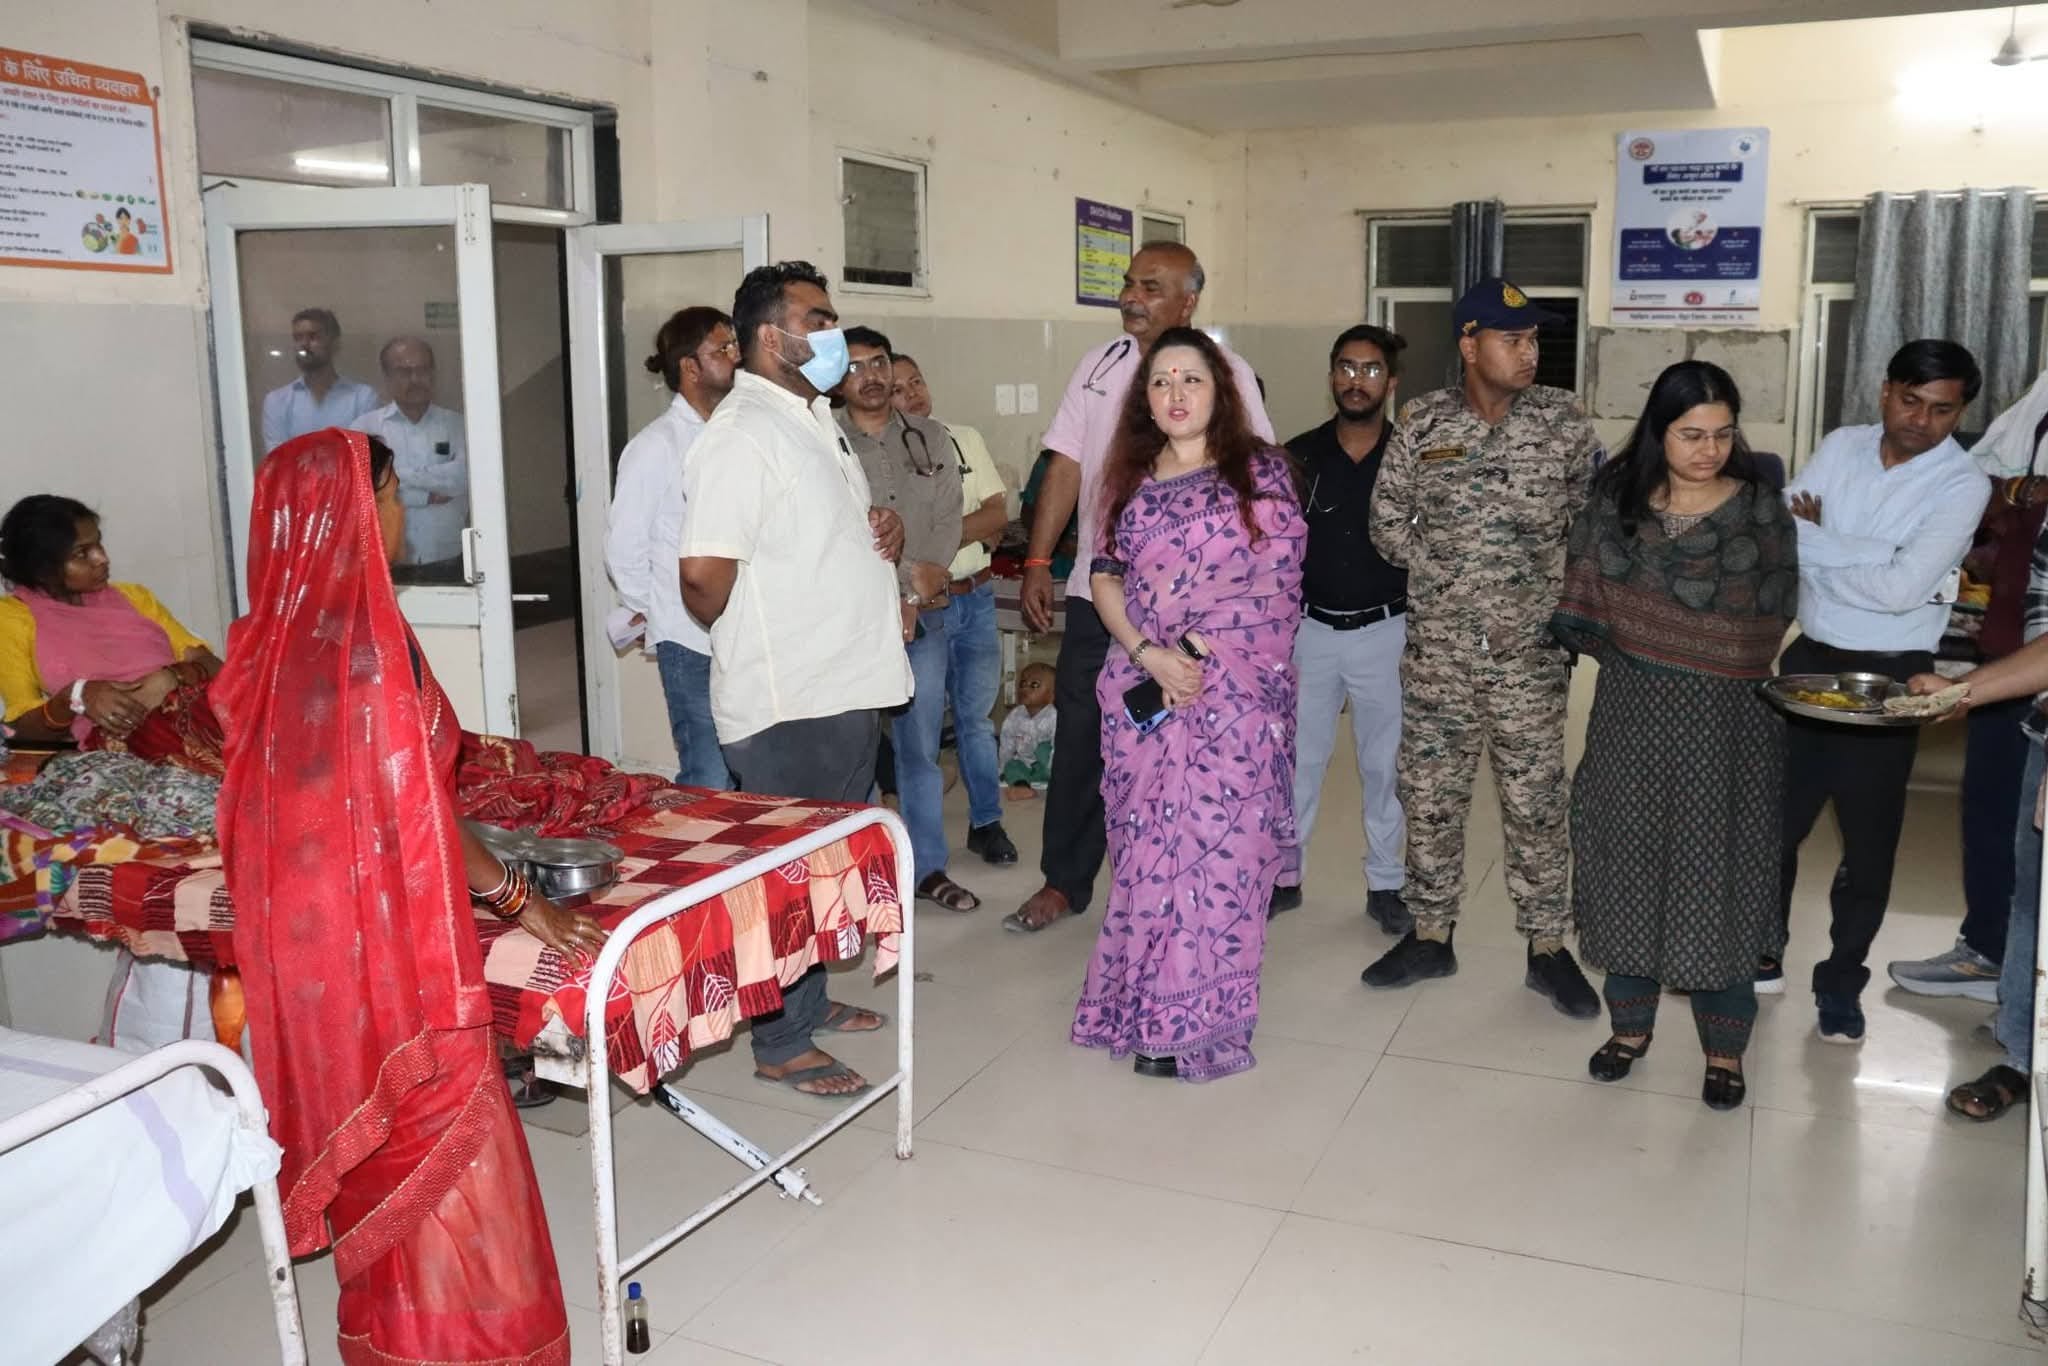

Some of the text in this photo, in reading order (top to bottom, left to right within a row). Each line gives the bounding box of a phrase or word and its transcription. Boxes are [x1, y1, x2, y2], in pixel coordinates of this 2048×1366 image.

[4, 57, 139, 97] के लिए उचित व्यवहार
